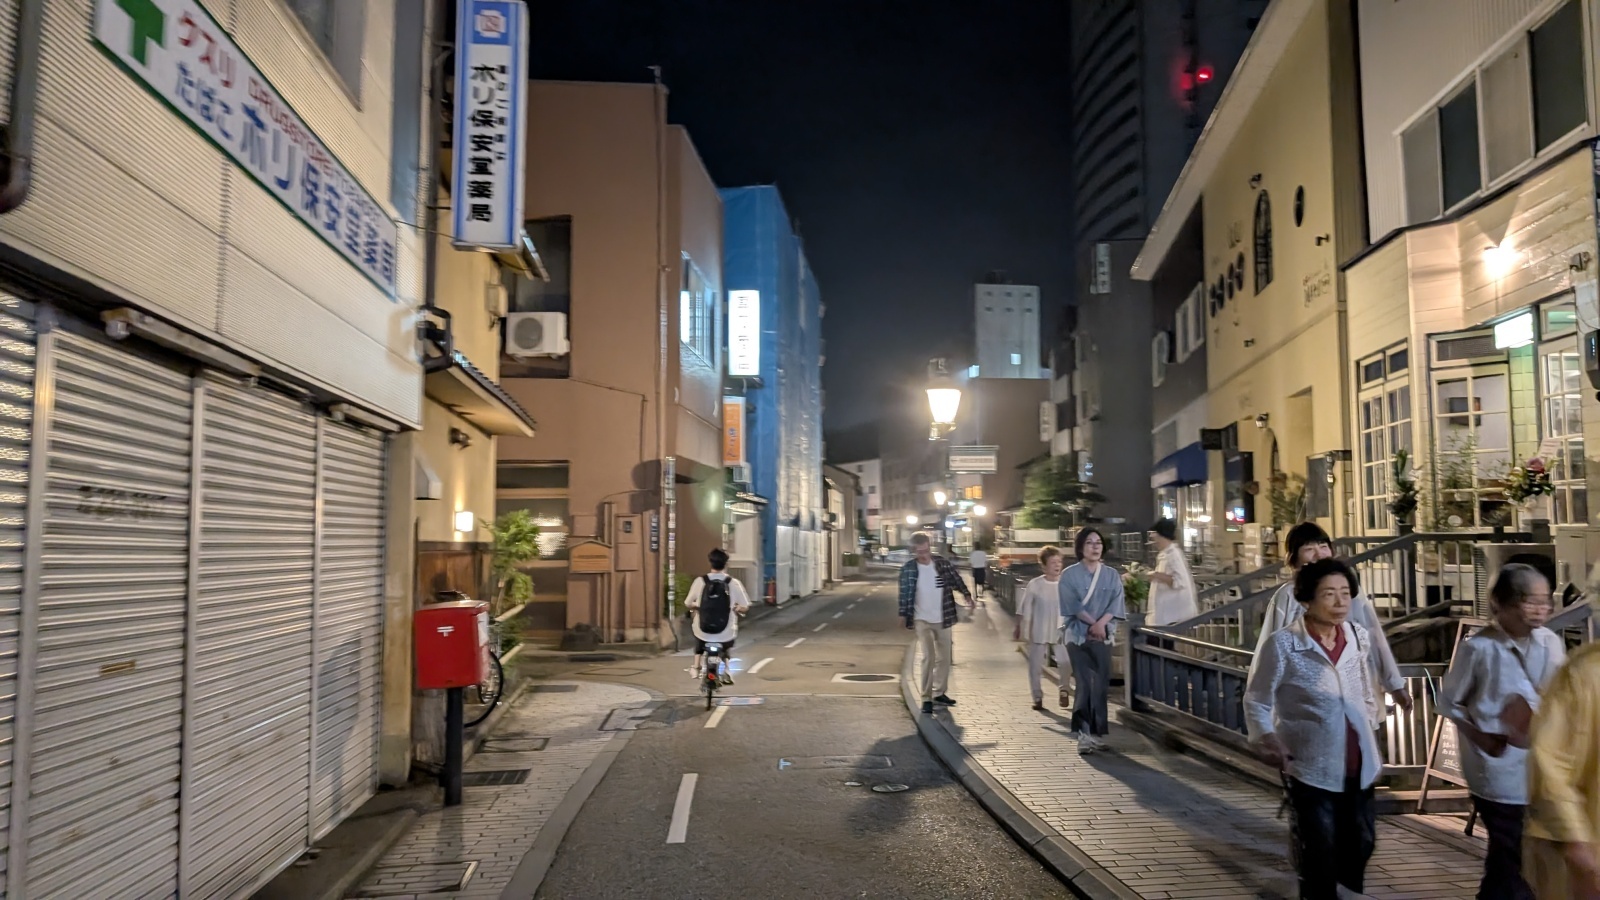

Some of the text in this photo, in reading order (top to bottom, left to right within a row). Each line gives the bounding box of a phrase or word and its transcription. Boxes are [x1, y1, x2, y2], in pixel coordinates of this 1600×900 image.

[178, 10, 237, 88] クスリ
[175, 61, 233, 142] たばこ
